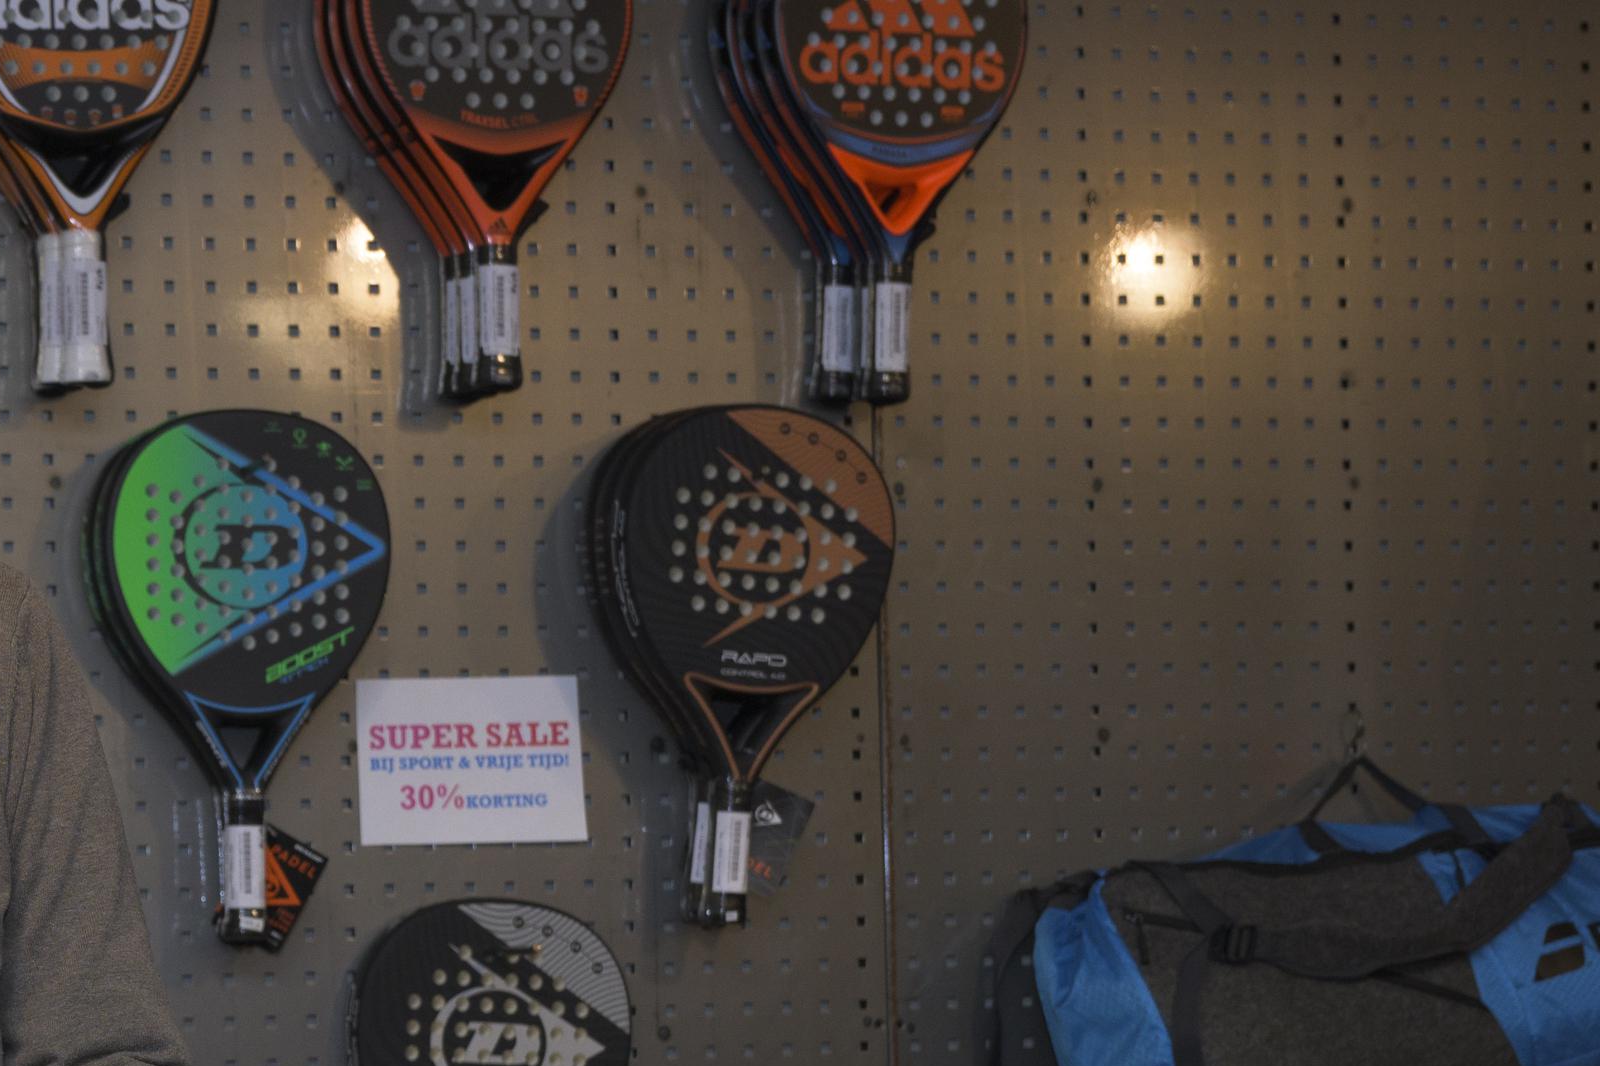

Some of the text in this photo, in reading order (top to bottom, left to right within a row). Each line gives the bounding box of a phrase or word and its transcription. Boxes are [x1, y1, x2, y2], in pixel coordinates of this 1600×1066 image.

[387, 13, 610, 74] adidas
[800, 28, 1006, 92] adidas
[369, 721, 570, 750] SUPER SALE
[370, 752, 569, 773] BIJ SPORT & VRIJE TIJD!
[400, 784, 548, 810] 30% KORTING
